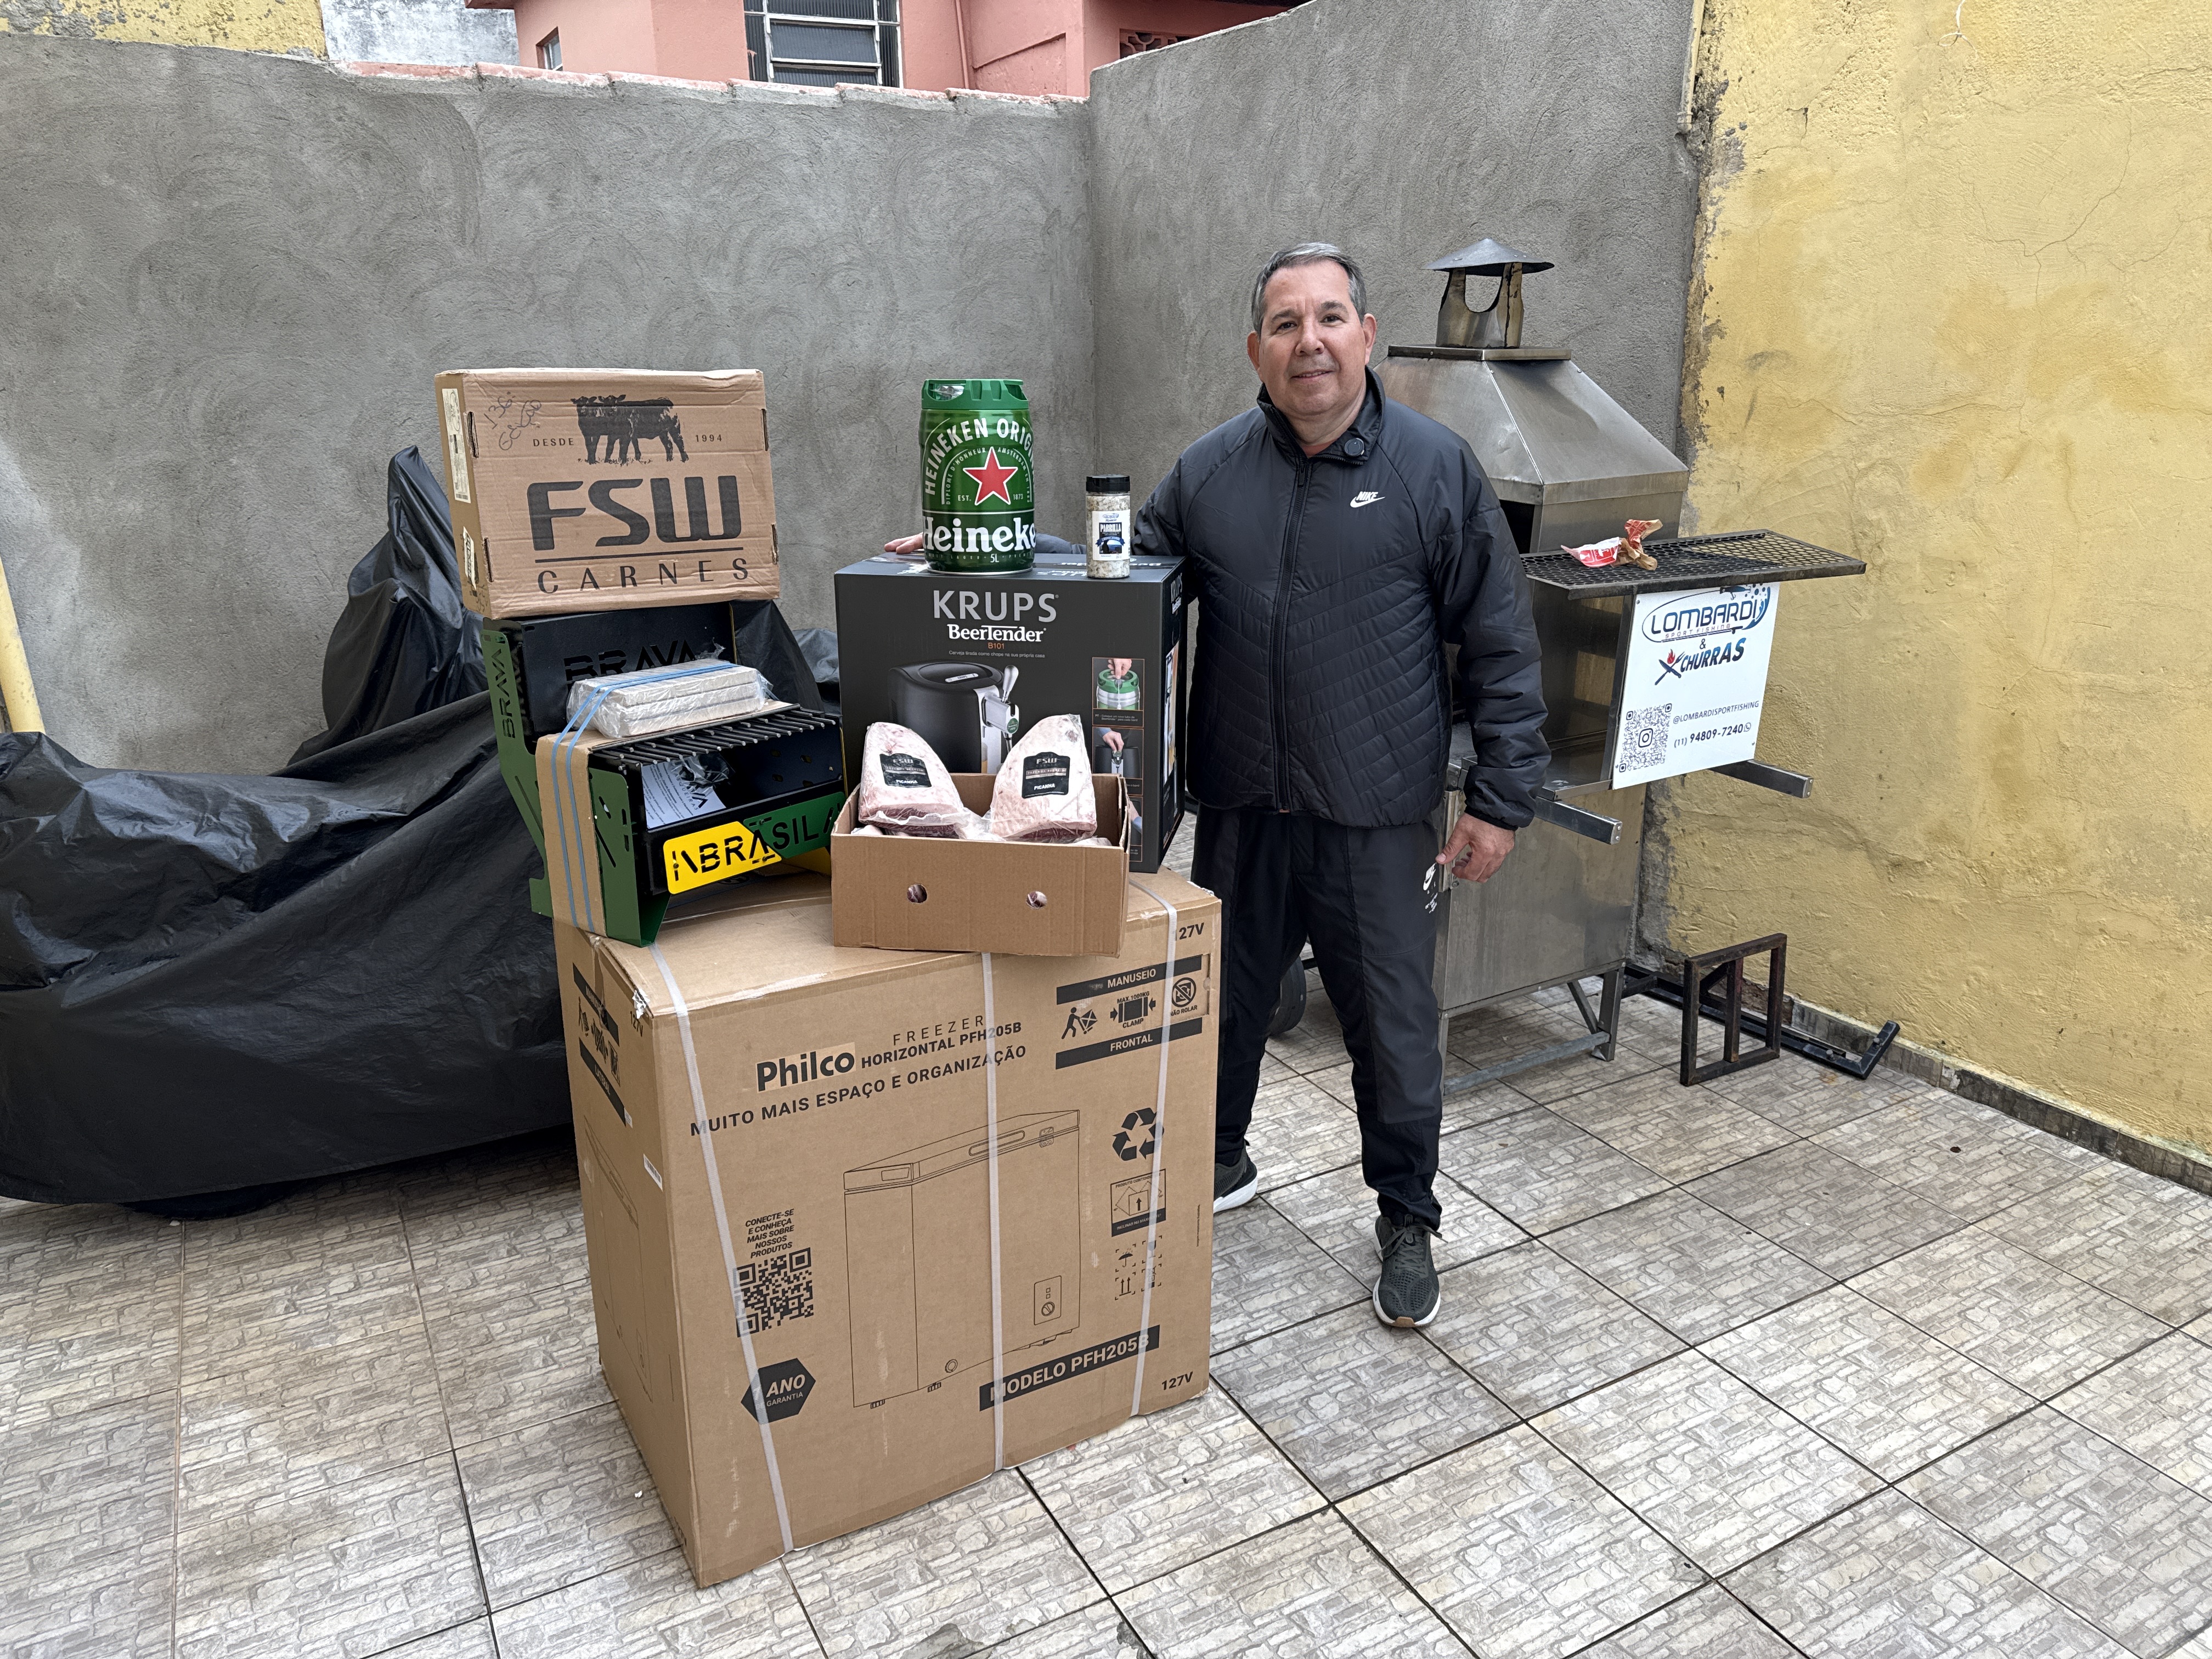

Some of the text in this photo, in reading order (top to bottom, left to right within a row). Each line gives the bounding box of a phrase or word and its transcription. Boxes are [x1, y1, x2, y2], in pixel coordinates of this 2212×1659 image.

[533, 438, 574, 447] DESDE
[695, 434, 723, 443] 1994
[925, 417, 988, 495] HEINEKEN
[1356, 492, 1379, 501] NIKE
[527, 476, 742, 551] FSW
[990, 553, 999, 563] 5L
[537, 558, 748, 594] CARNES
[933, 590, 1057, 623] KRUPS
[1651, 599, 1758, 635] LOMBARDI
[947, 624, 1044, 642] BeerTender
[1665, 623, 1731, 639] SPORT FISHING
[1699, 638, 1706, 650] &
[1680, 637, 1747, 673] CHURRAS
[491, 648, 516, 739] BRAVA
[1673, 701, 1759, 724] @LOMBARDISPORTFISHING
[1674, 724, 1743, 748] (11) 94809-7240
[698, 815, 819, 873] BRASIL
[1175, 922, 1204, 941] 27V
[1107, 968, 1156, 989] MANUSEIO
[1181, 1005, 1198, 1014] ROLAR
[630, 1011, 644, 1037] 127V
[893, 1015, 984, 1046] FREEZER
[1122, 1018, 1144, 1029] CLAMP
[1110, 1034, 1153, 1052] FRONTAL
[757, 1022, 1022, 1092] Philco HORIZONTAL PFH205B
[690, 1045, 1026, 1137] MUITO MAIS ESPAÇO E ORGANIZAÇÃO
[746, 1209, 794, 1227] CONECTE-SE
[755, 1218, 792, 1233] CONHEÇA
[747, 1225, 795, 1244] MAIS SOBRE
[755, 1235, 787, 1250] NOSSOS
[751, 1242, 793, 1259] PRODUTOS
[1071, 1334, 1149, 1372] PFH205B
[766, 1374, 805, 1398] ANO
[1161, 1372, 1194, 1391] 127V
[766, 1392, 804, 1407] GARANTIA
